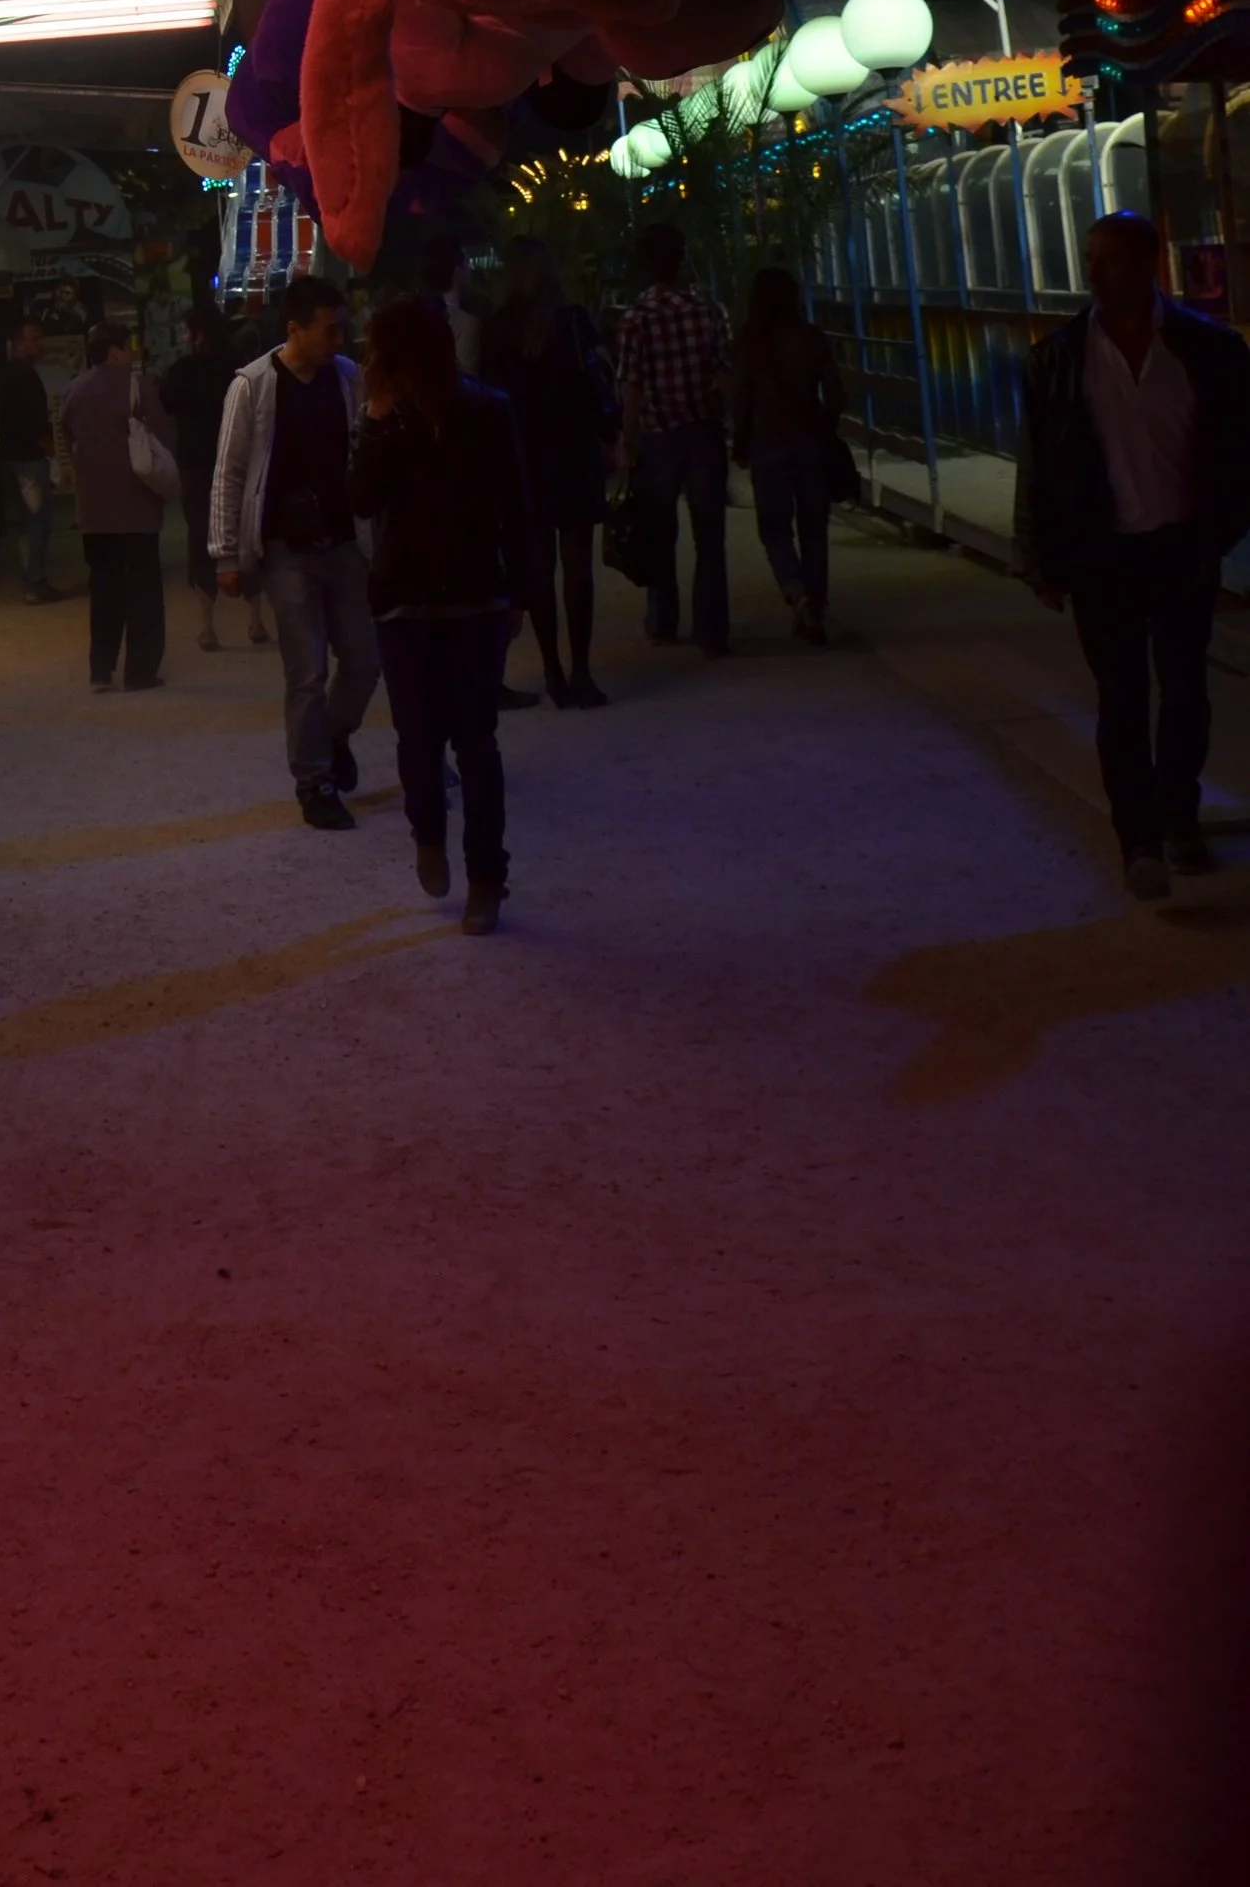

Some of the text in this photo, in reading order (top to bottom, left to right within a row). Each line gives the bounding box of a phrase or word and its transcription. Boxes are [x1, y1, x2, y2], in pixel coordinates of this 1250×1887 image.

[933, 73, 1046, 109] ENTREE
[181, 91, 211, 147] 1
[183, 146, 196, 158] LA
